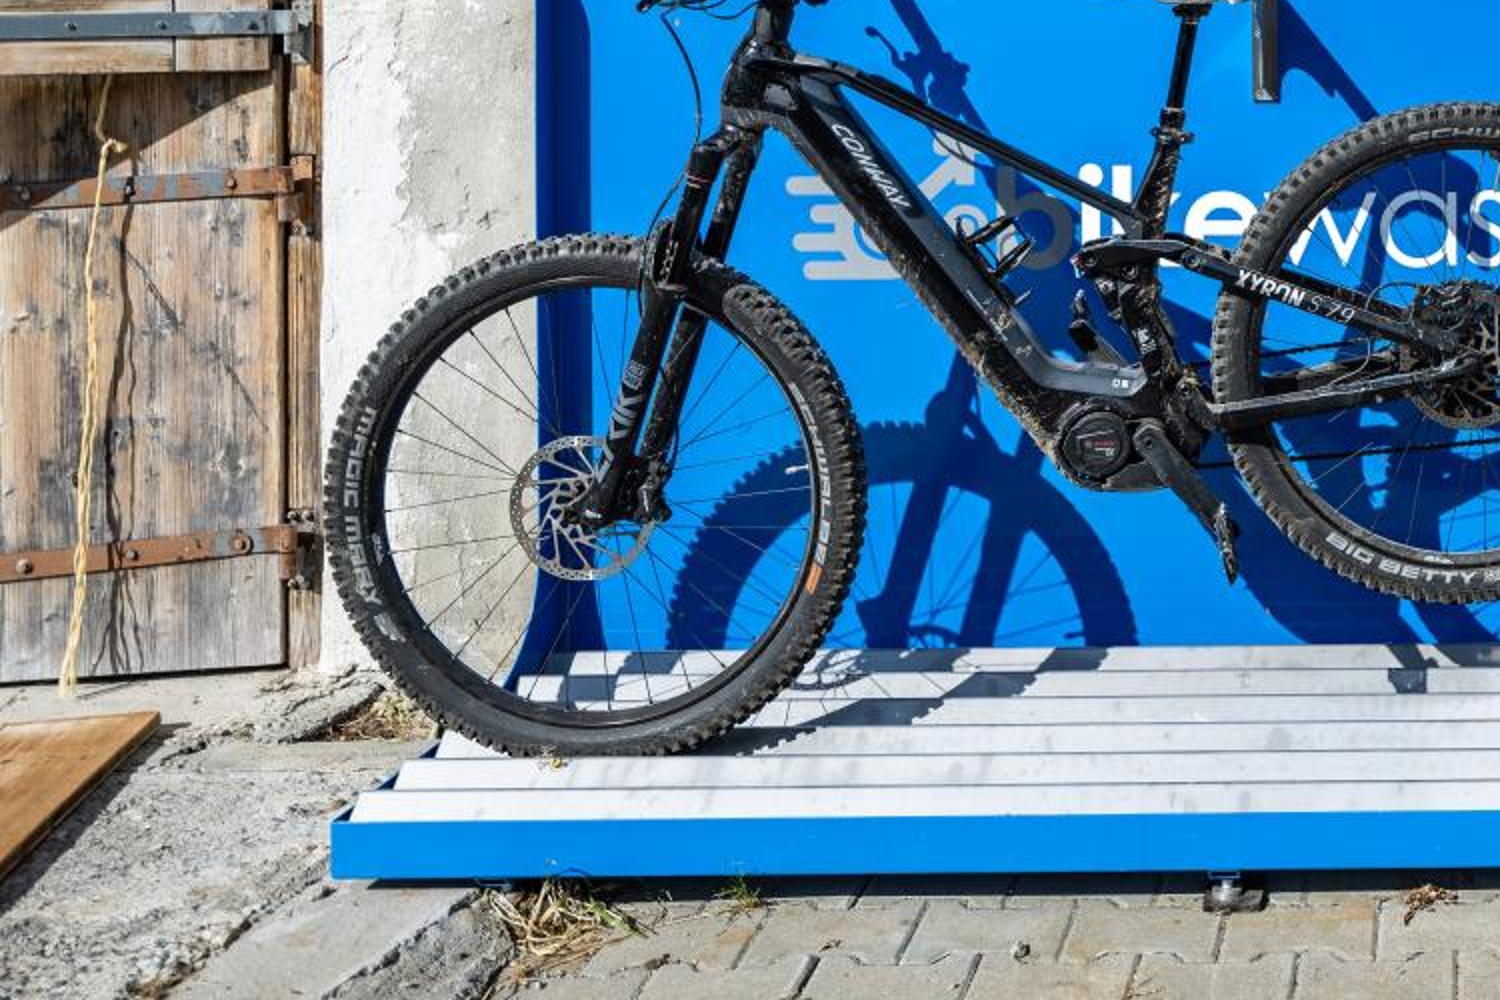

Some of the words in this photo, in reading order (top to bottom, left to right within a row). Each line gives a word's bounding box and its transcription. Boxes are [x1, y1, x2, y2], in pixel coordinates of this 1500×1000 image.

[831, 122, 912, 209] CONWAY
[1234, 268, 1307, 308] XYRON
[343, 406, 378, 509] MAGIC
[344, 515, 383, 605] MARY
[1325, 531, 1376, 566] BIG
[1377, 560, 1477, 585] BETTY
